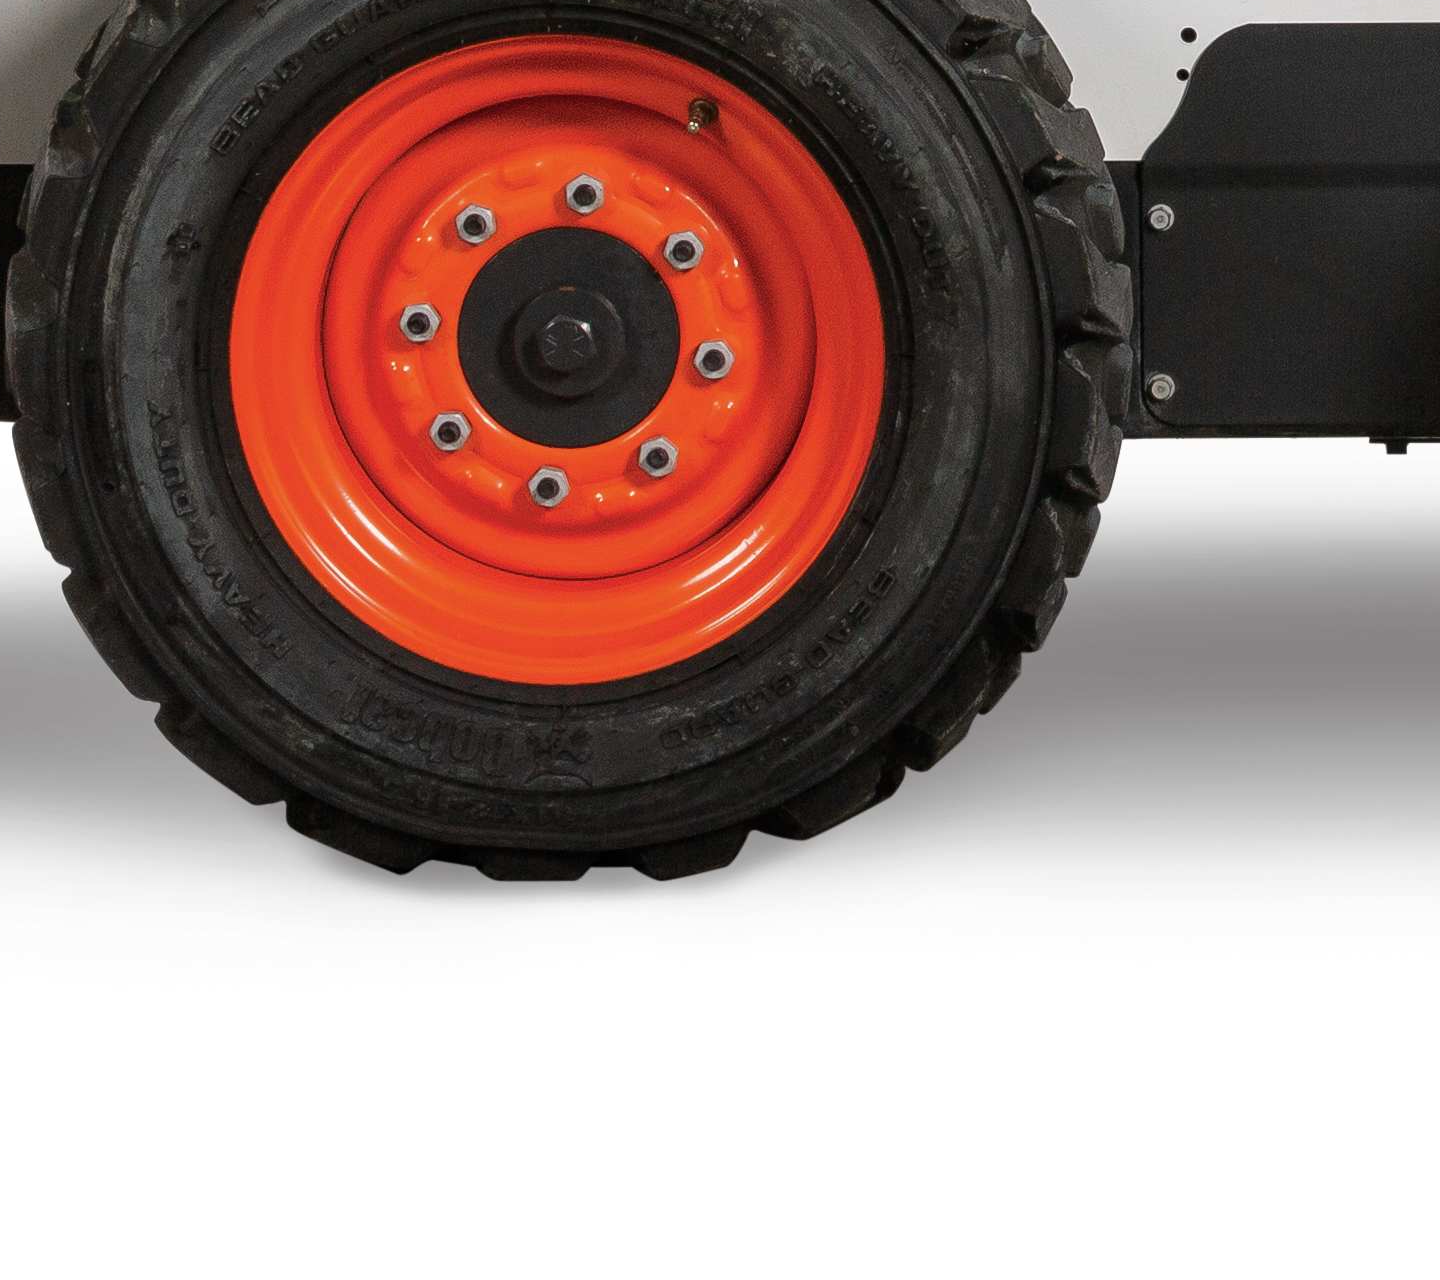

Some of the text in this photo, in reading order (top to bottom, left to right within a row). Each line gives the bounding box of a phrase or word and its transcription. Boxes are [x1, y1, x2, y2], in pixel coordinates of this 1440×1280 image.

[209, 56, 305, 157] BEAD
[148, 399, 293, 661] HEAVY DUTY
